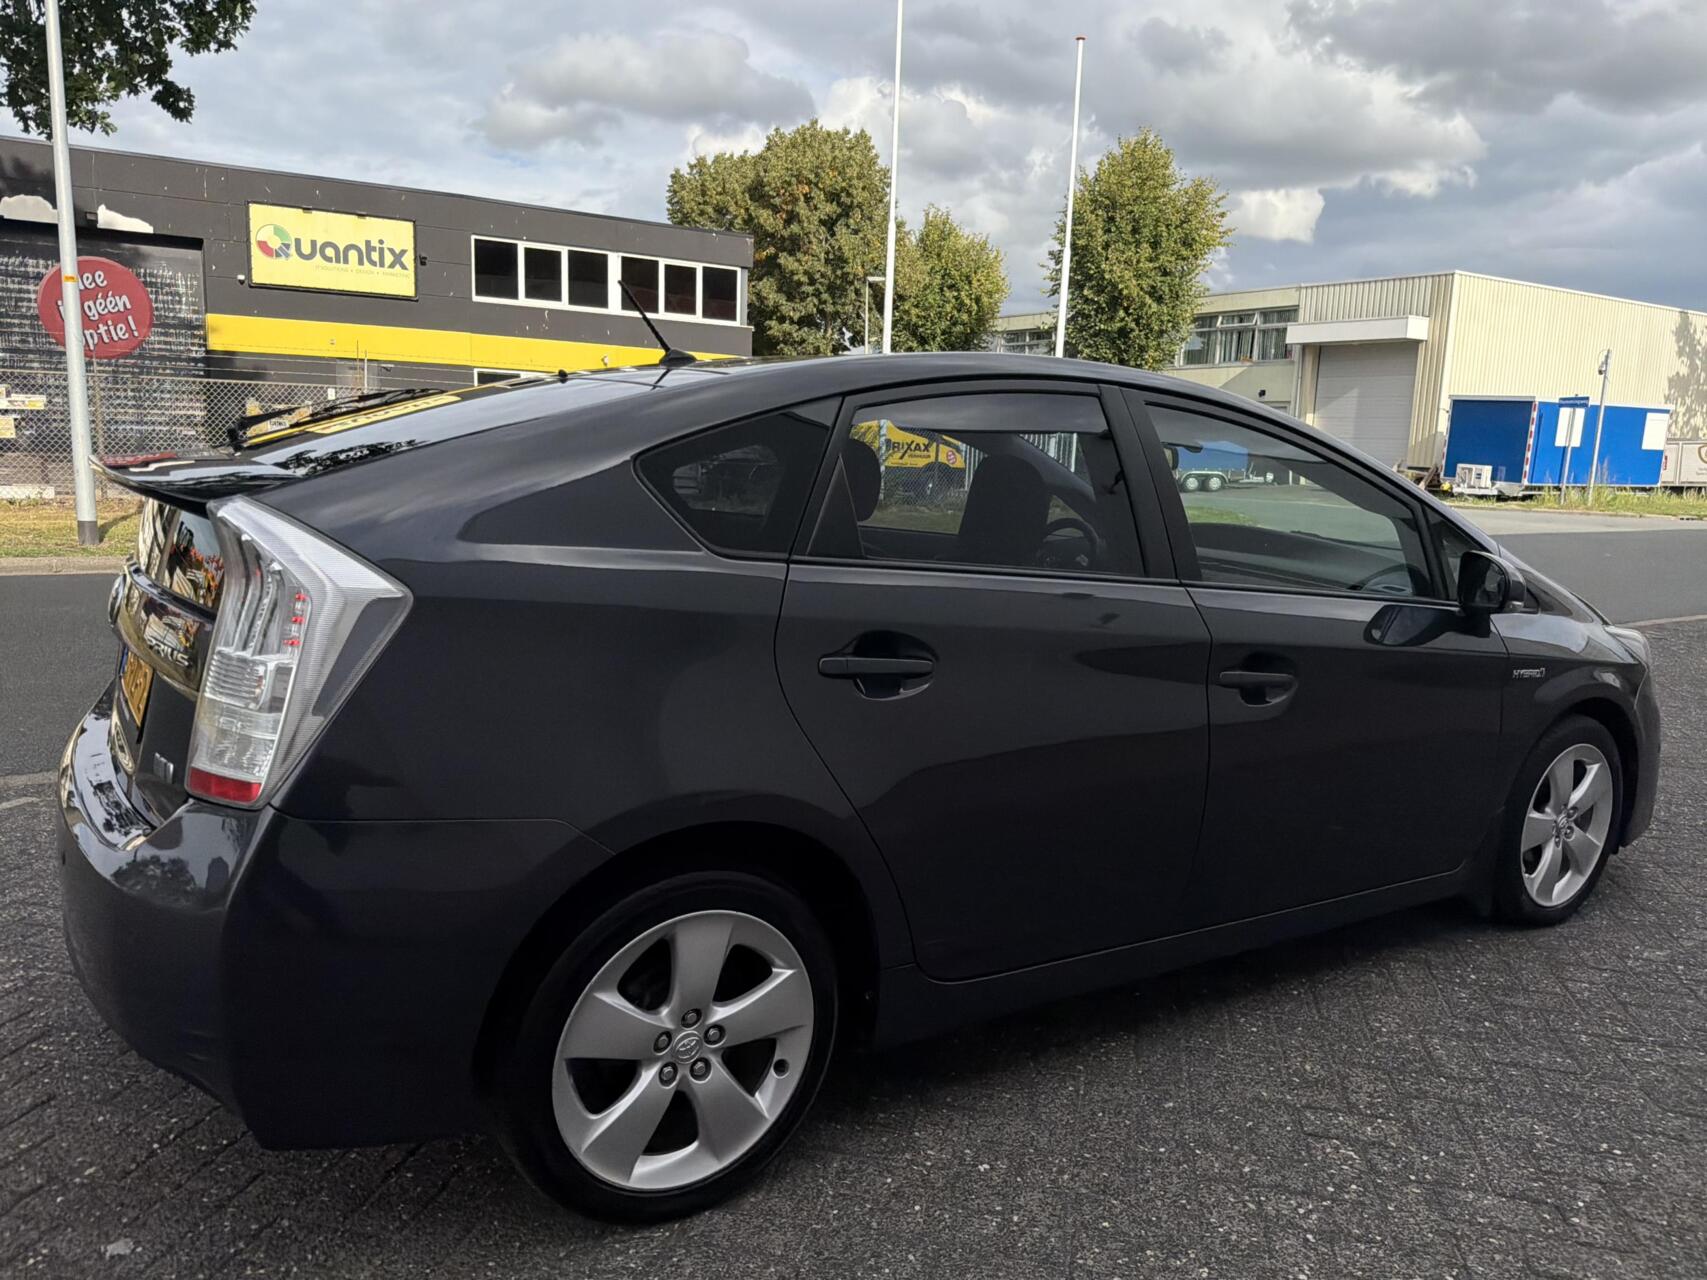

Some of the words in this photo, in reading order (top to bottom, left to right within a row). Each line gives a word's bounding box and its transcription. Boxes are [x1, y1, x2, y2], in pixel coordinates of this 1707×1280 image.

[256, 223, 409, 271] Quantix
[83, 290, 132, 321] géén
[82, 315, 139, 350] ptie!
[144, 635, 189, 667] PRIUS
